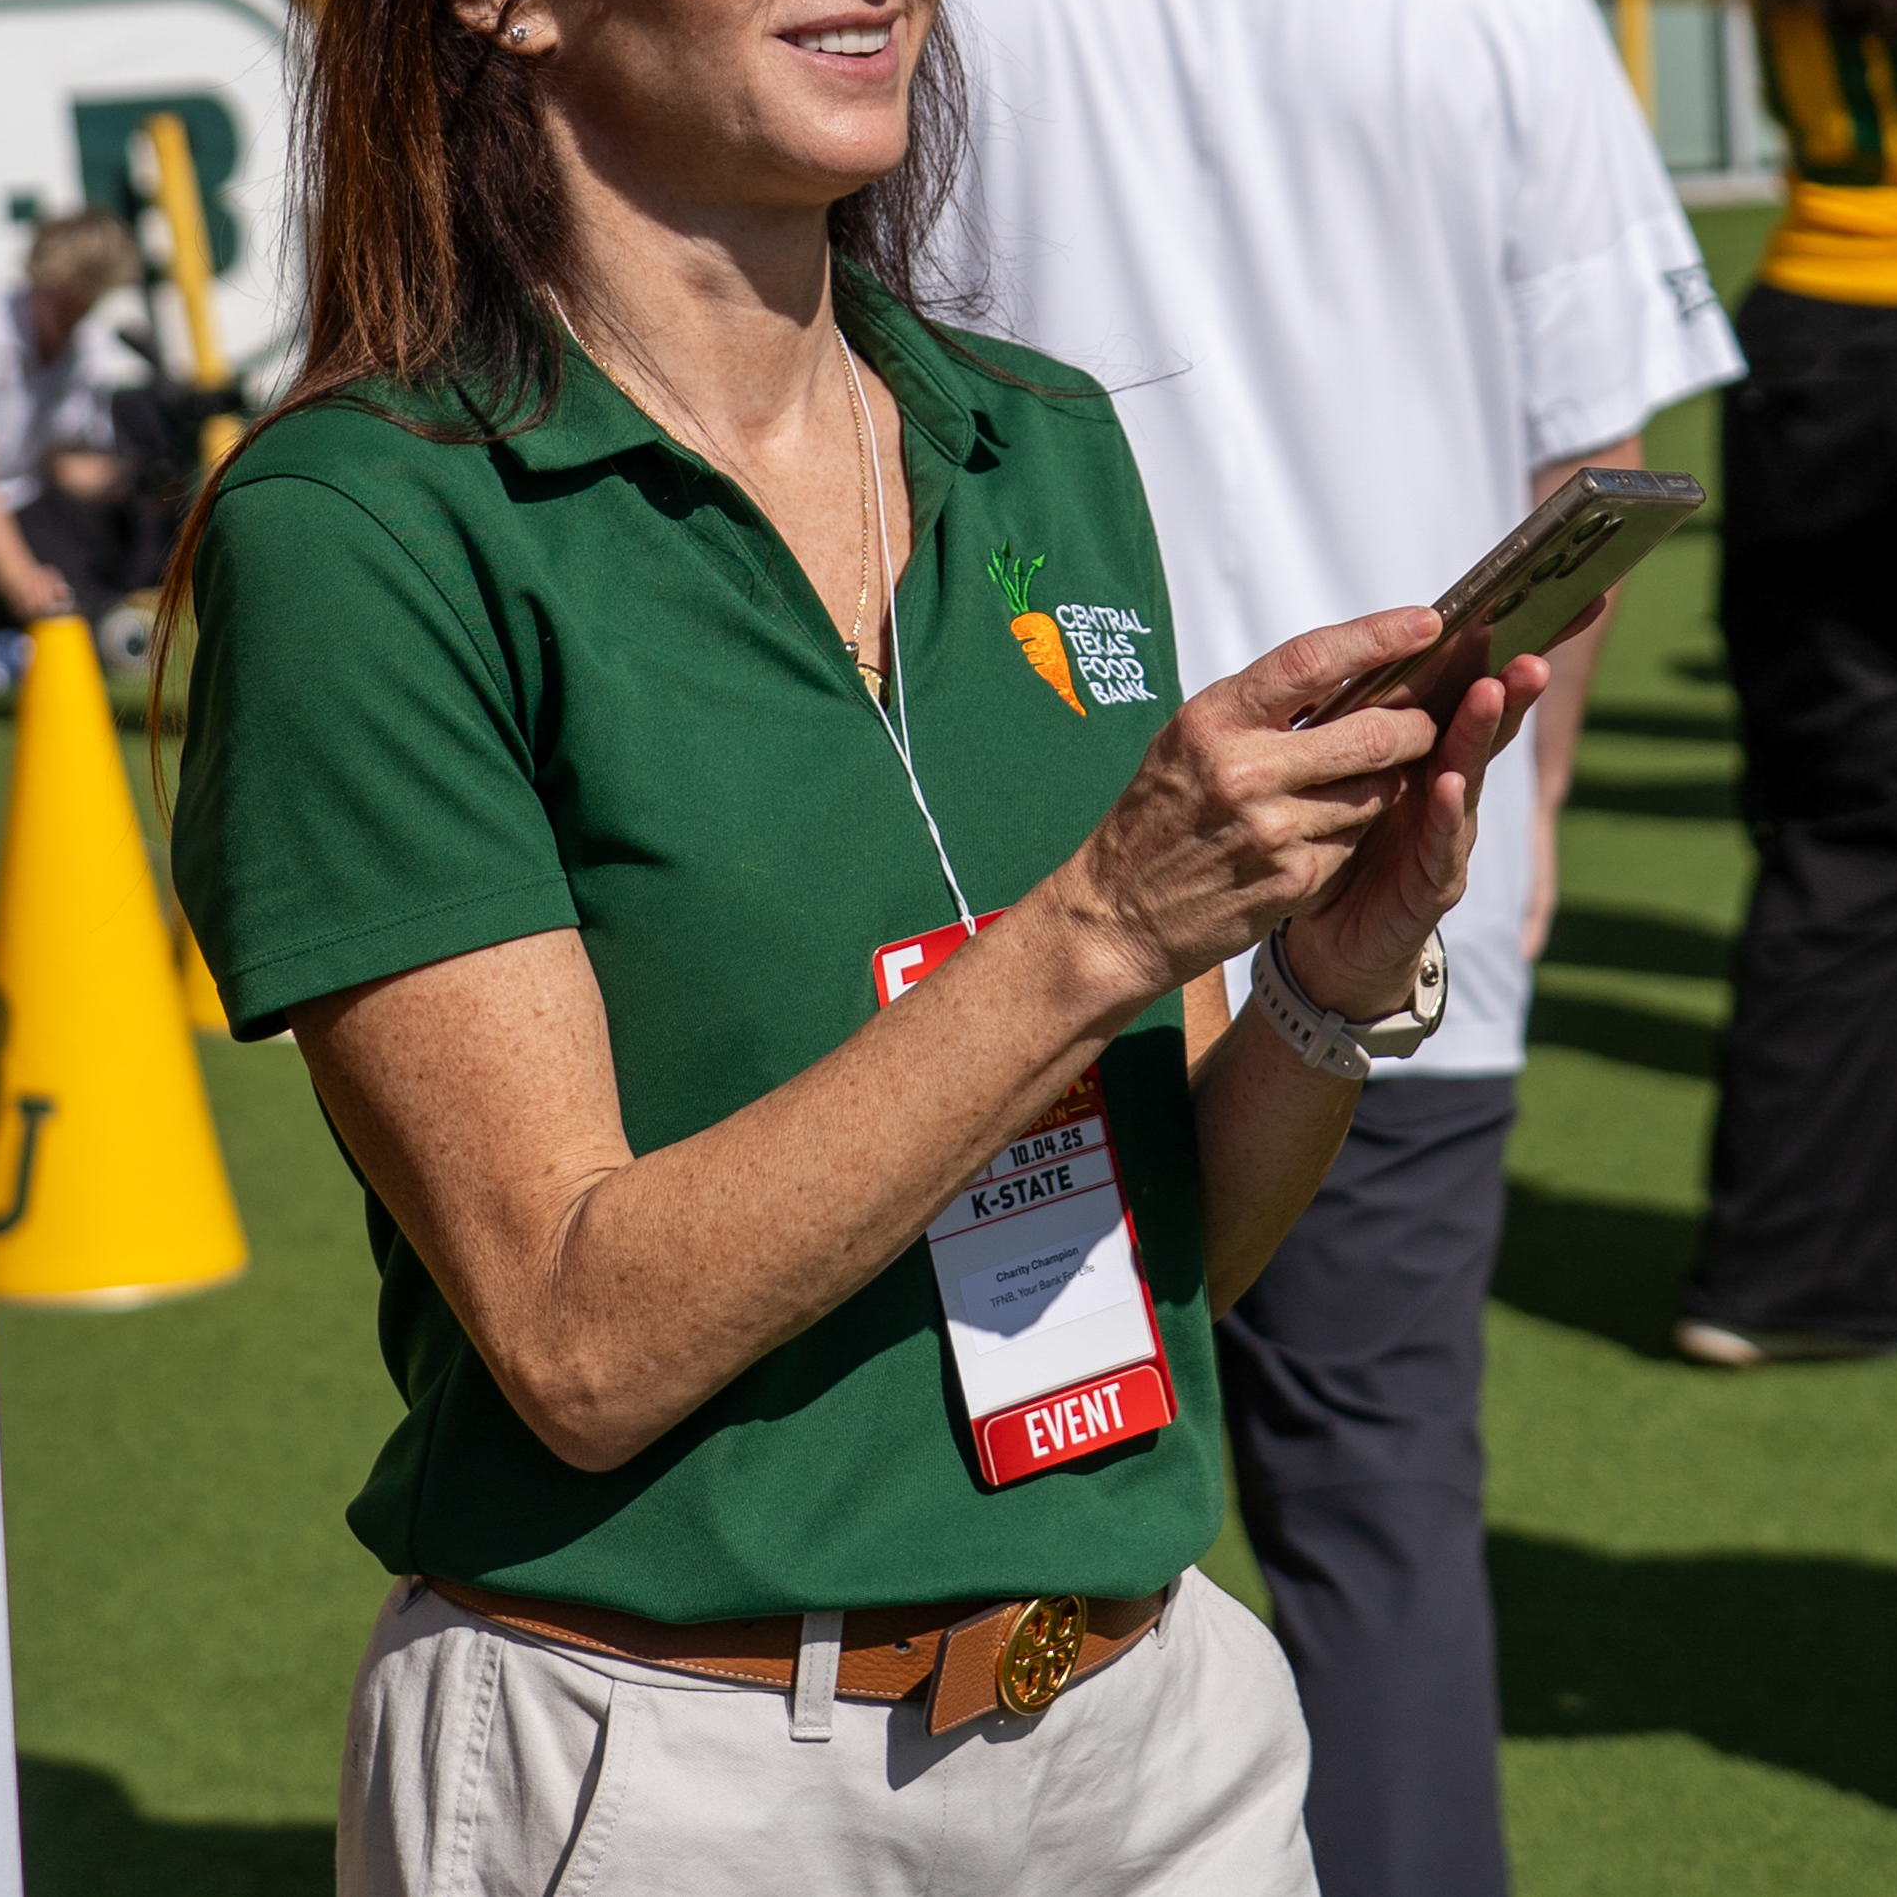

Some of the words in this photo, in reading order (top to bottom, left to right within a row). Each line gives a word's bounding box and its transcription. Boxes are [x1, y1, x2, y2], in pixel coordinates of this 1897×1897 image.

[1056, 604, 1152, 634] CENTRAL
[1066, 631, 1136, 656] TEXAS
[1077, 656, 1144, 681] FOOD
[1089, 679, 1158, 705] BANK
[1009, 1126, 1084, 1168] 10.04.25
[971, 1163, 1074, 1220] K-STATE
[995, 1263, 1031, 1283] Charity
[1030, 1246, 1080, 1271] Champion
[1017, 1284, 1038, 1299] Your
[1039, 1275, 1063, 1291] Bank
[1063, 1270, 1077, 1283] For
[1024, 1381, 1125, 1459] EVENT
